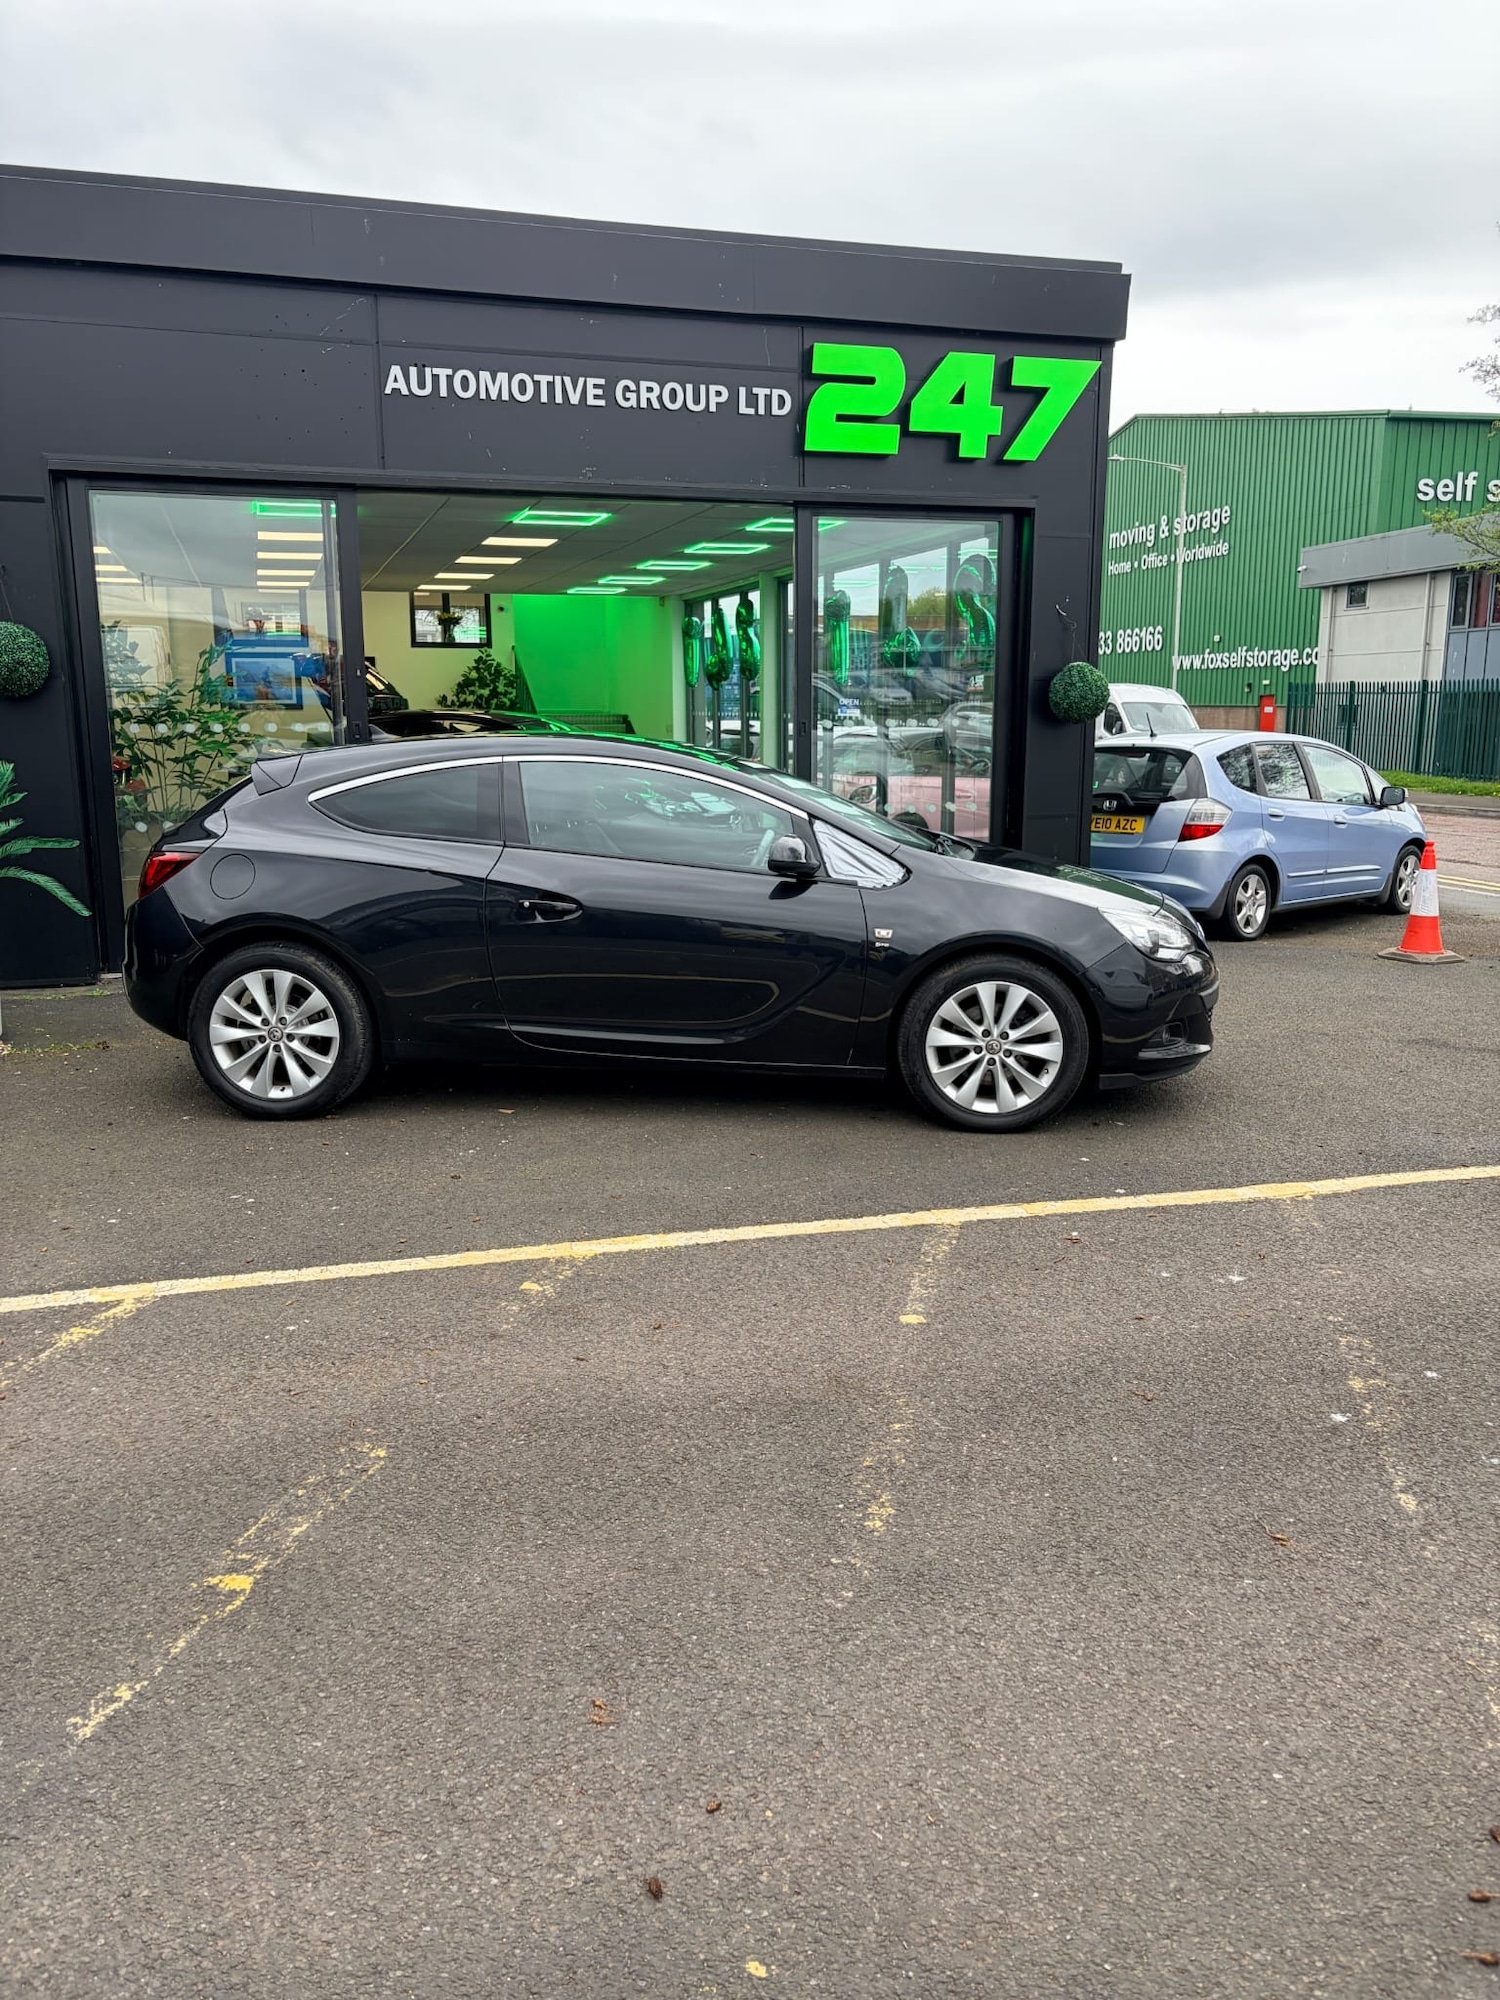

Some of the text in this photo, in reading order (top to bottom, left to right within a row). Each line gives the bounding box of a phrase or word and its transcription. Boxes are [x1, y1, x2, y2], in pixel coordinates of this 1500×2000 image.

[384, 364, 793, 416] AUTOMOTIVE GROUP LTD
[804, 342, 1102, 461] 247
[1417, 471, 1479, 502] self
[1108, 505, 1231, 550] moving & storage
[1108, 539, 1229, 576] Home Office Worldwide
[1116, 625, 1163, 654] 866166
[1172, 646, 1319, 672] www.foxselfstorage.co
[1115, 818, 1138, 831] AZC
